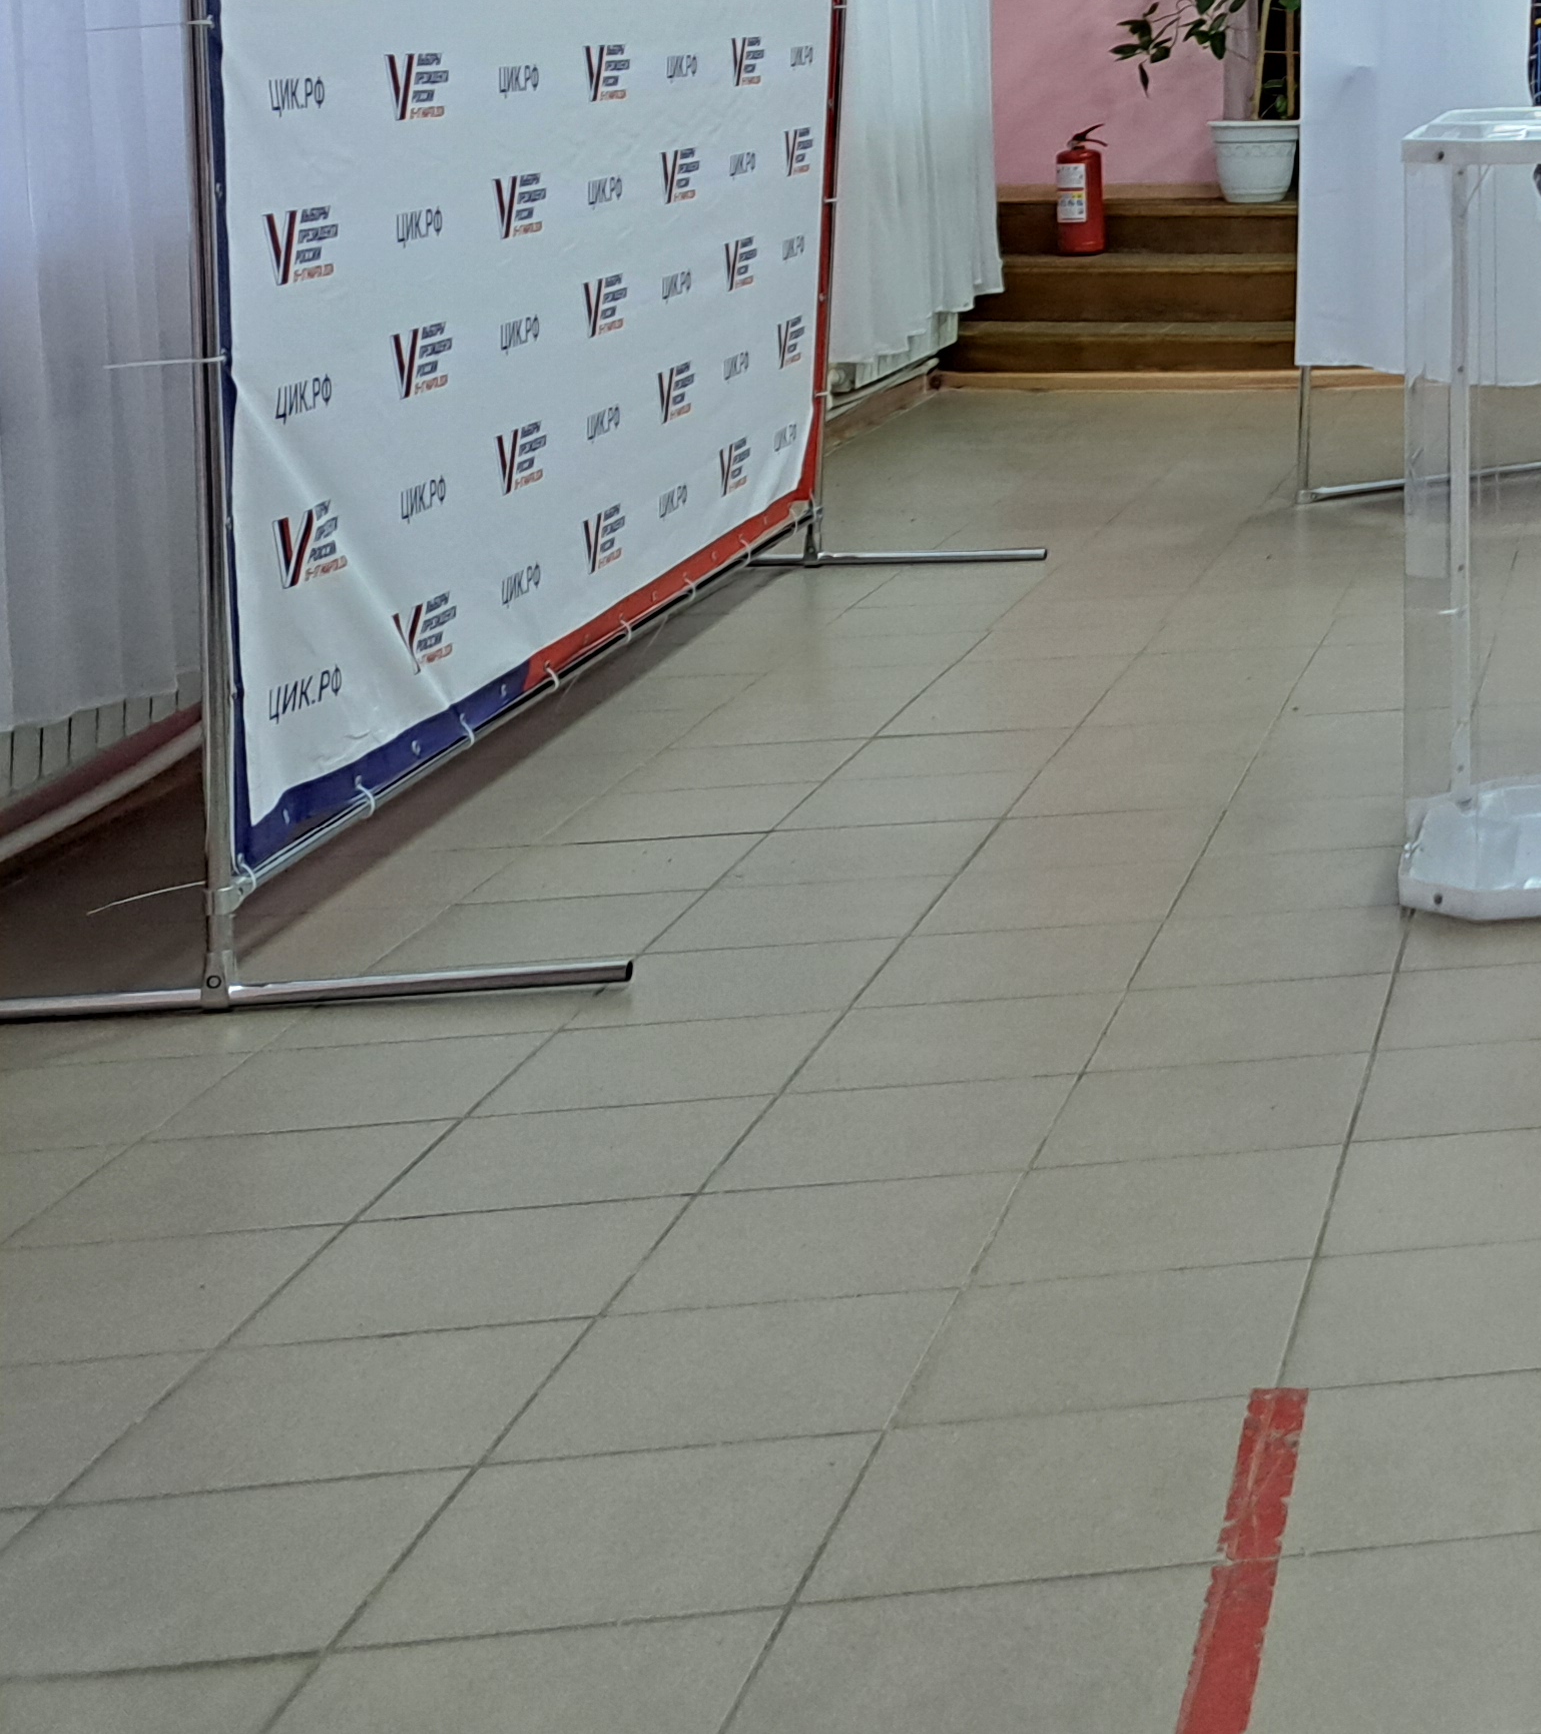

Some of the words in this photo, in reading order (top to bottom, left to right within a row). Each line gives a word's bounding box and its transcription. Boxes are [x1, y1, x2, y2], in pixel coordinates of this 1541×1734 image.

[268, 76, 326, 118] ЦИК.РФ
[396, 206, 443, 249] ЦИК.РФ
[274, 373, 333, 426] ЦИК.РФ
[400, 474, 447, 525] ЦИК.РФ
[268, 664, 342, 725] ЦИК.РФ
